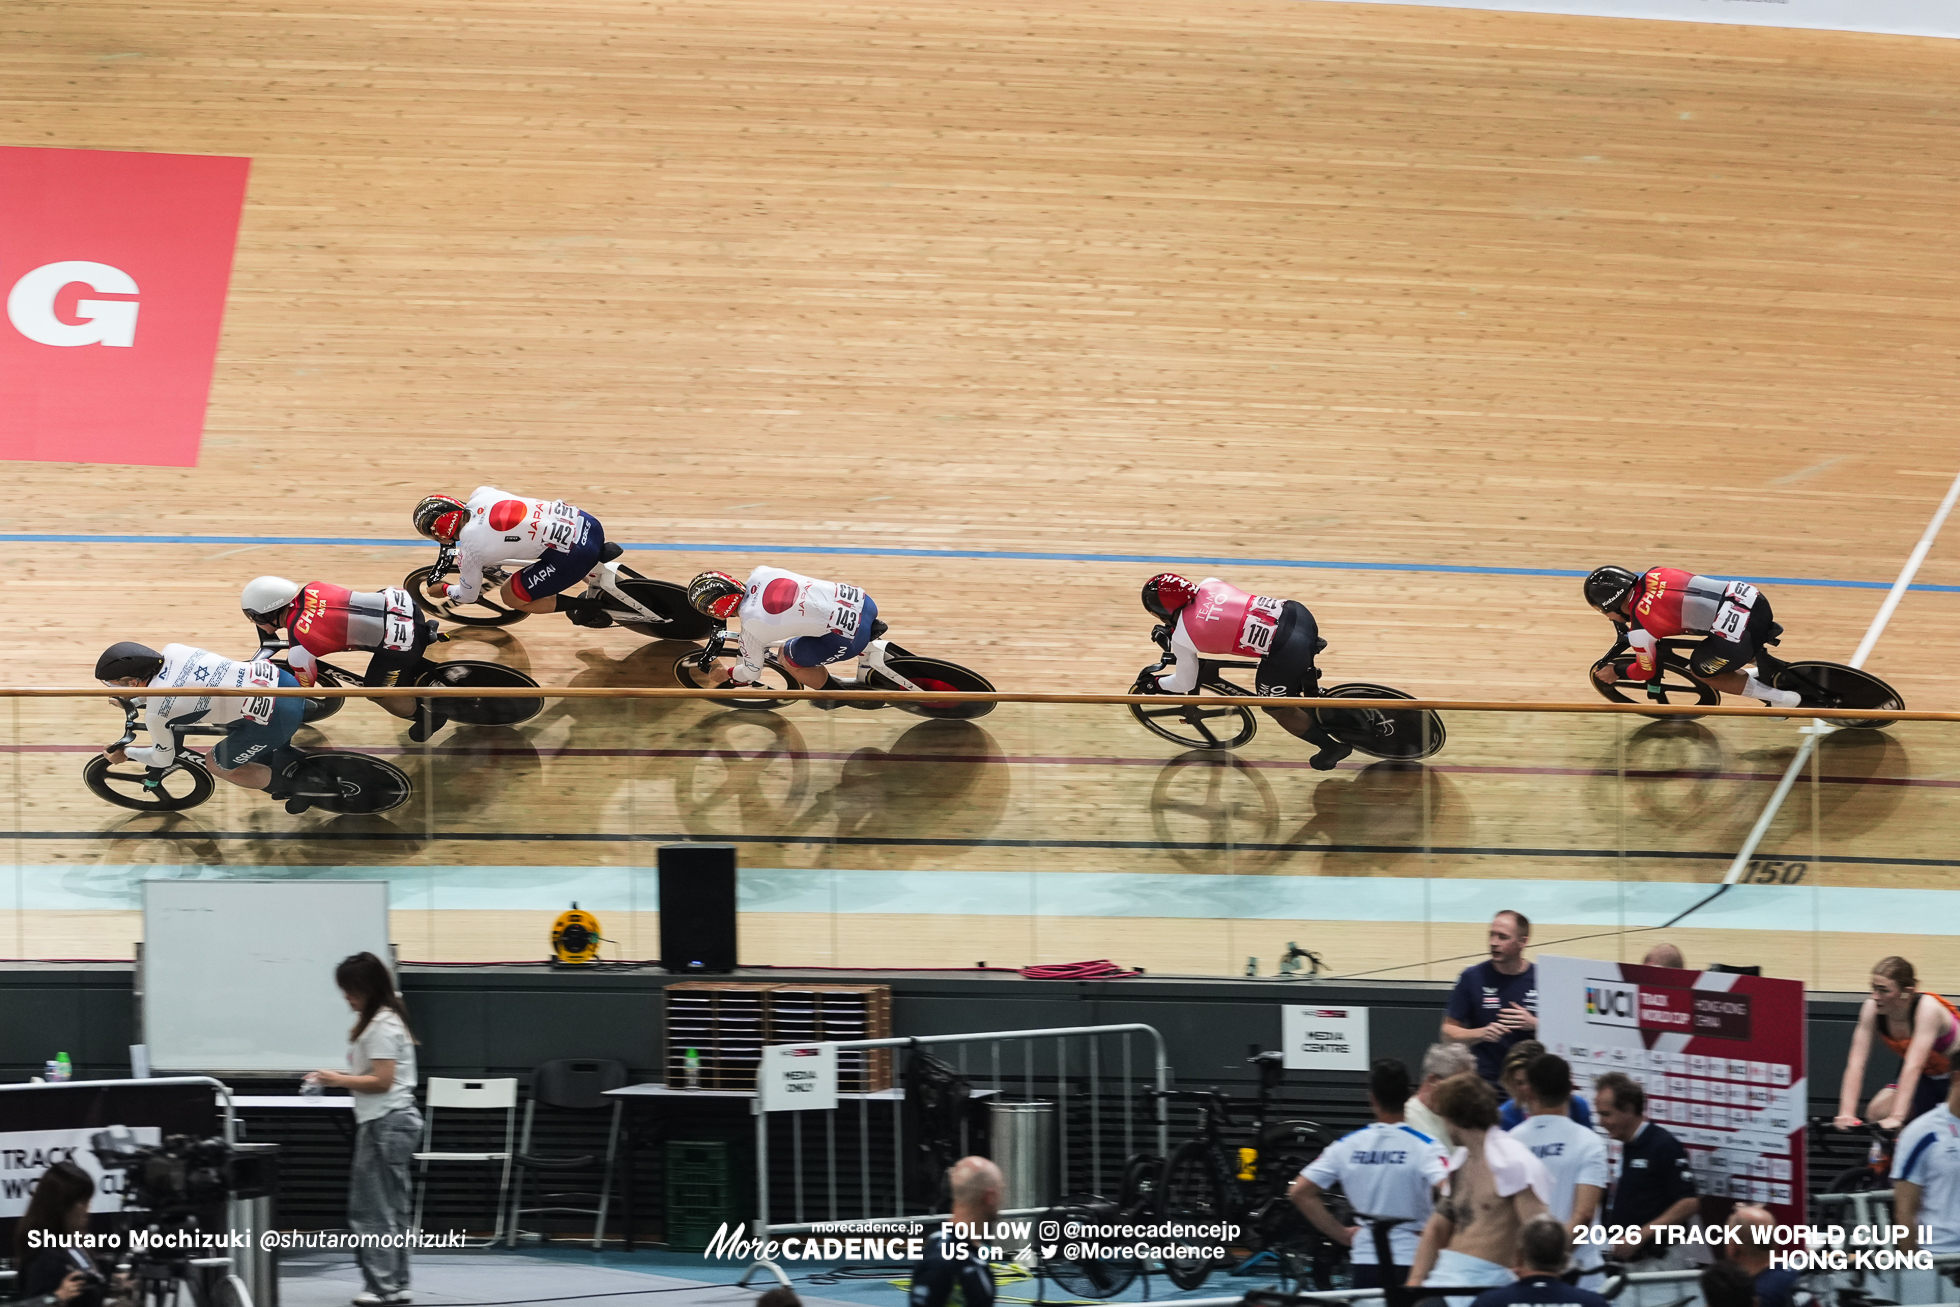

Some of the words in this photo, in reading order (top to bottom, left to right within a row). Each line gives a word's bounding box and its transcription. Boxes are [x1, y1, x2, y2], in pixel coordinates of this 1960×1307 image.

[7, 261, 140, 347] G
[528, 500, 544, 541] JAPA
[549, 522, 572, 546] 142
[1638, 572, 1662, 616] CHINA
[1656, 581, 1667, 599] ANTA
[263, 598, 285, 611] LAZER
[297, 588, 320, 635] CHINA
[317, 600, 327, 618] ANTA
[723, 595, 739, 617] JAPAN
[1196, 591, 1217, 620] TEAM
[1205, 593, 1228, 622] TTO
[836, 607, 857, 632] 143
[1720, 610, 1740, 634] 79
[392, 623, 408, 644] 74
[1247, 623, 1270, 648] 170
[249, 697, 270, 718] 130
[233, 744, 268, 765] ISRAEL
[1741, 861, 1807, 884] 150
[1594, 988, 1634, 1018] UCI
[1305, 1031, 1346, 1041] MEDIA
[1301, 1043, 1350, 1053] CENTRE
[1350, 1150, 1408, 1165] FRANCE
